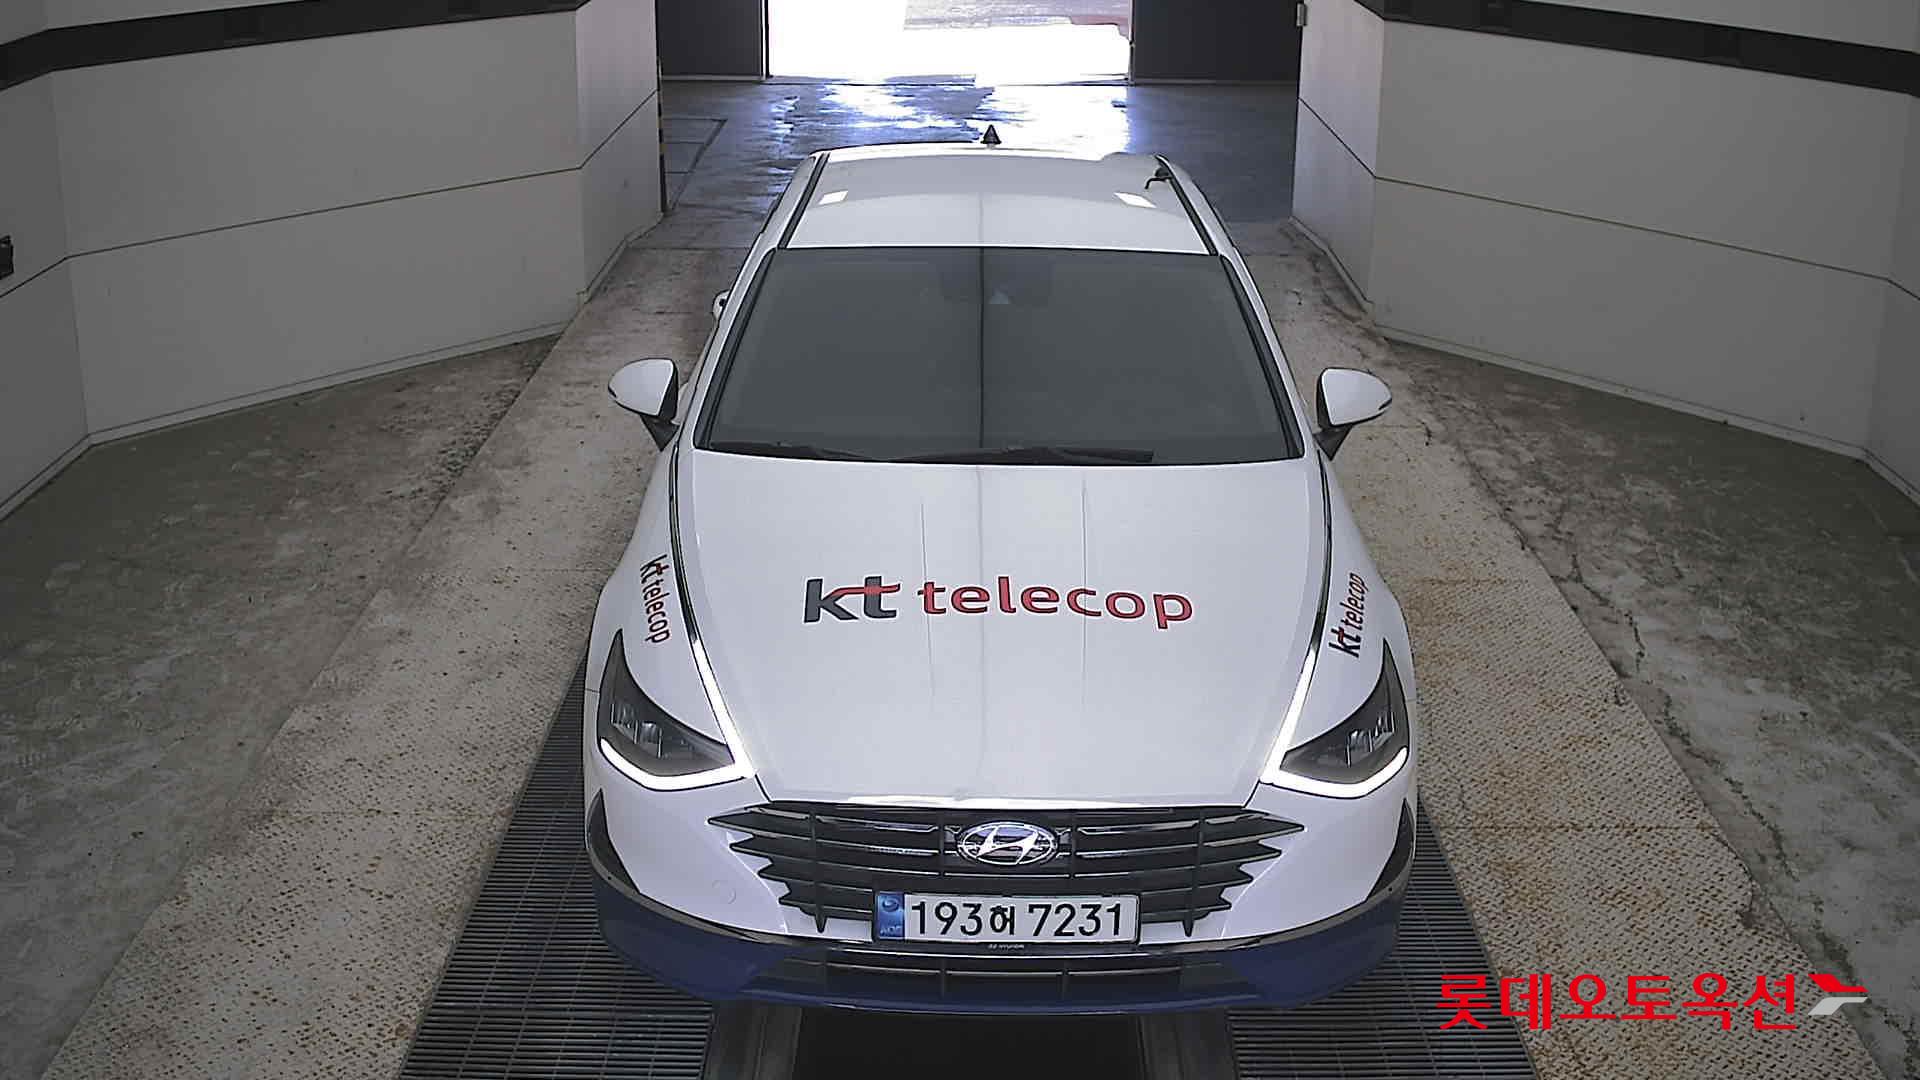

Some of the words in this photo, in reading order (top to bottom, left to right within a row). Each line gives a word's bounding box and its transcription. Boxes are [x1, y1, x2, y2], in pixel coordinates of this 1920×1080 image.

[640, 554, 669, 584] kt
[641, 577, 670, 643] telecop
[803, 576, 900, 623] kt
[917, 576, 1193, 630] telecop
[1339, 573, 1369, 630] telecop
[1328, 627, 1362, 658] kt
[910, 901, 1015, 936] 193허
[1027, 903, 1122, 937] 7231
